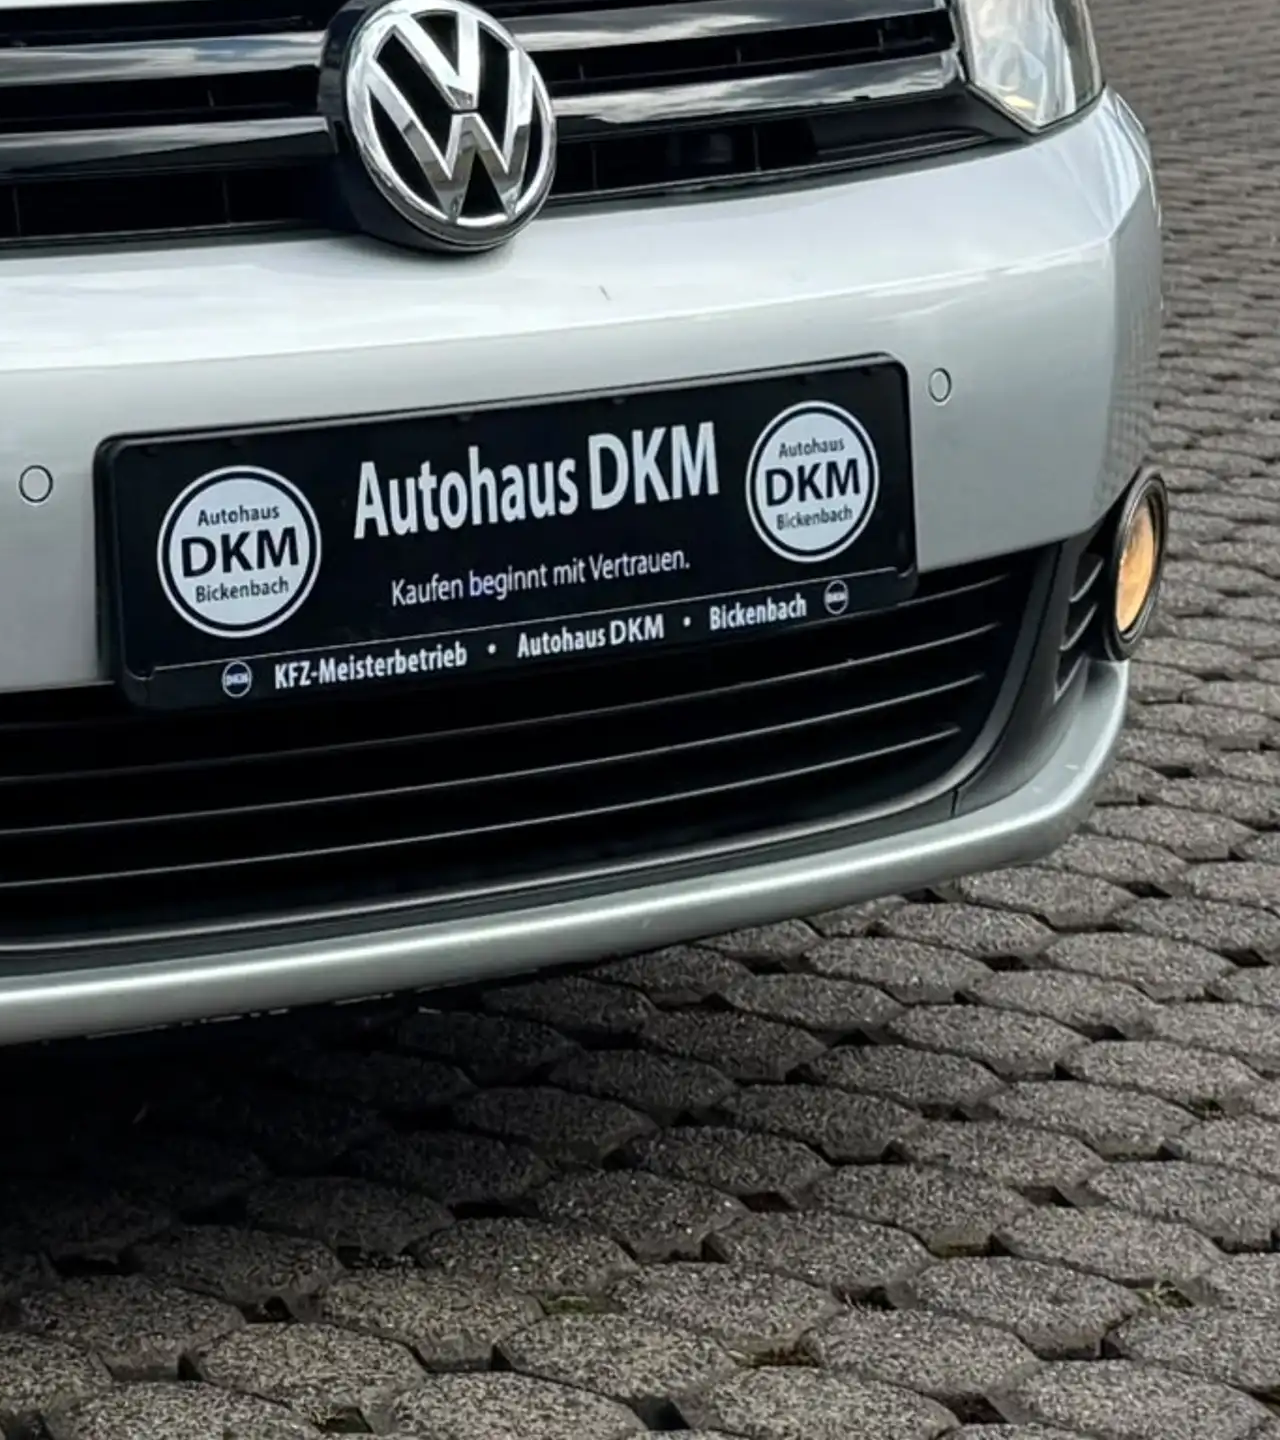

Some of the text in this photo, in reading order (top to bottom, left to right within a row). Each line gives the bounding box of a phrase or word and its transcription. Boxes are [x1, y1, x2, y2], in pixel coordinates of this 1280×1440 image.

[778, 437, 845, 459] Autohaus
[353, 421, 720, 540] Autohaus DKM
[764, 457, 861, 508] DKM
[197, 504, 280, 527] Autohaus
[776, 504, 854, 532] Bickenbach
[181, 525, 300, 579] DKM
[195, 575, 289, 604] Bickenbach
[391, 549, 690, 607] Kaufen beginnt mit Vertrauen.
[274, 592, 807, 690] KFZ-Meisterbetrieb Autohaus DKM Bickenbach
